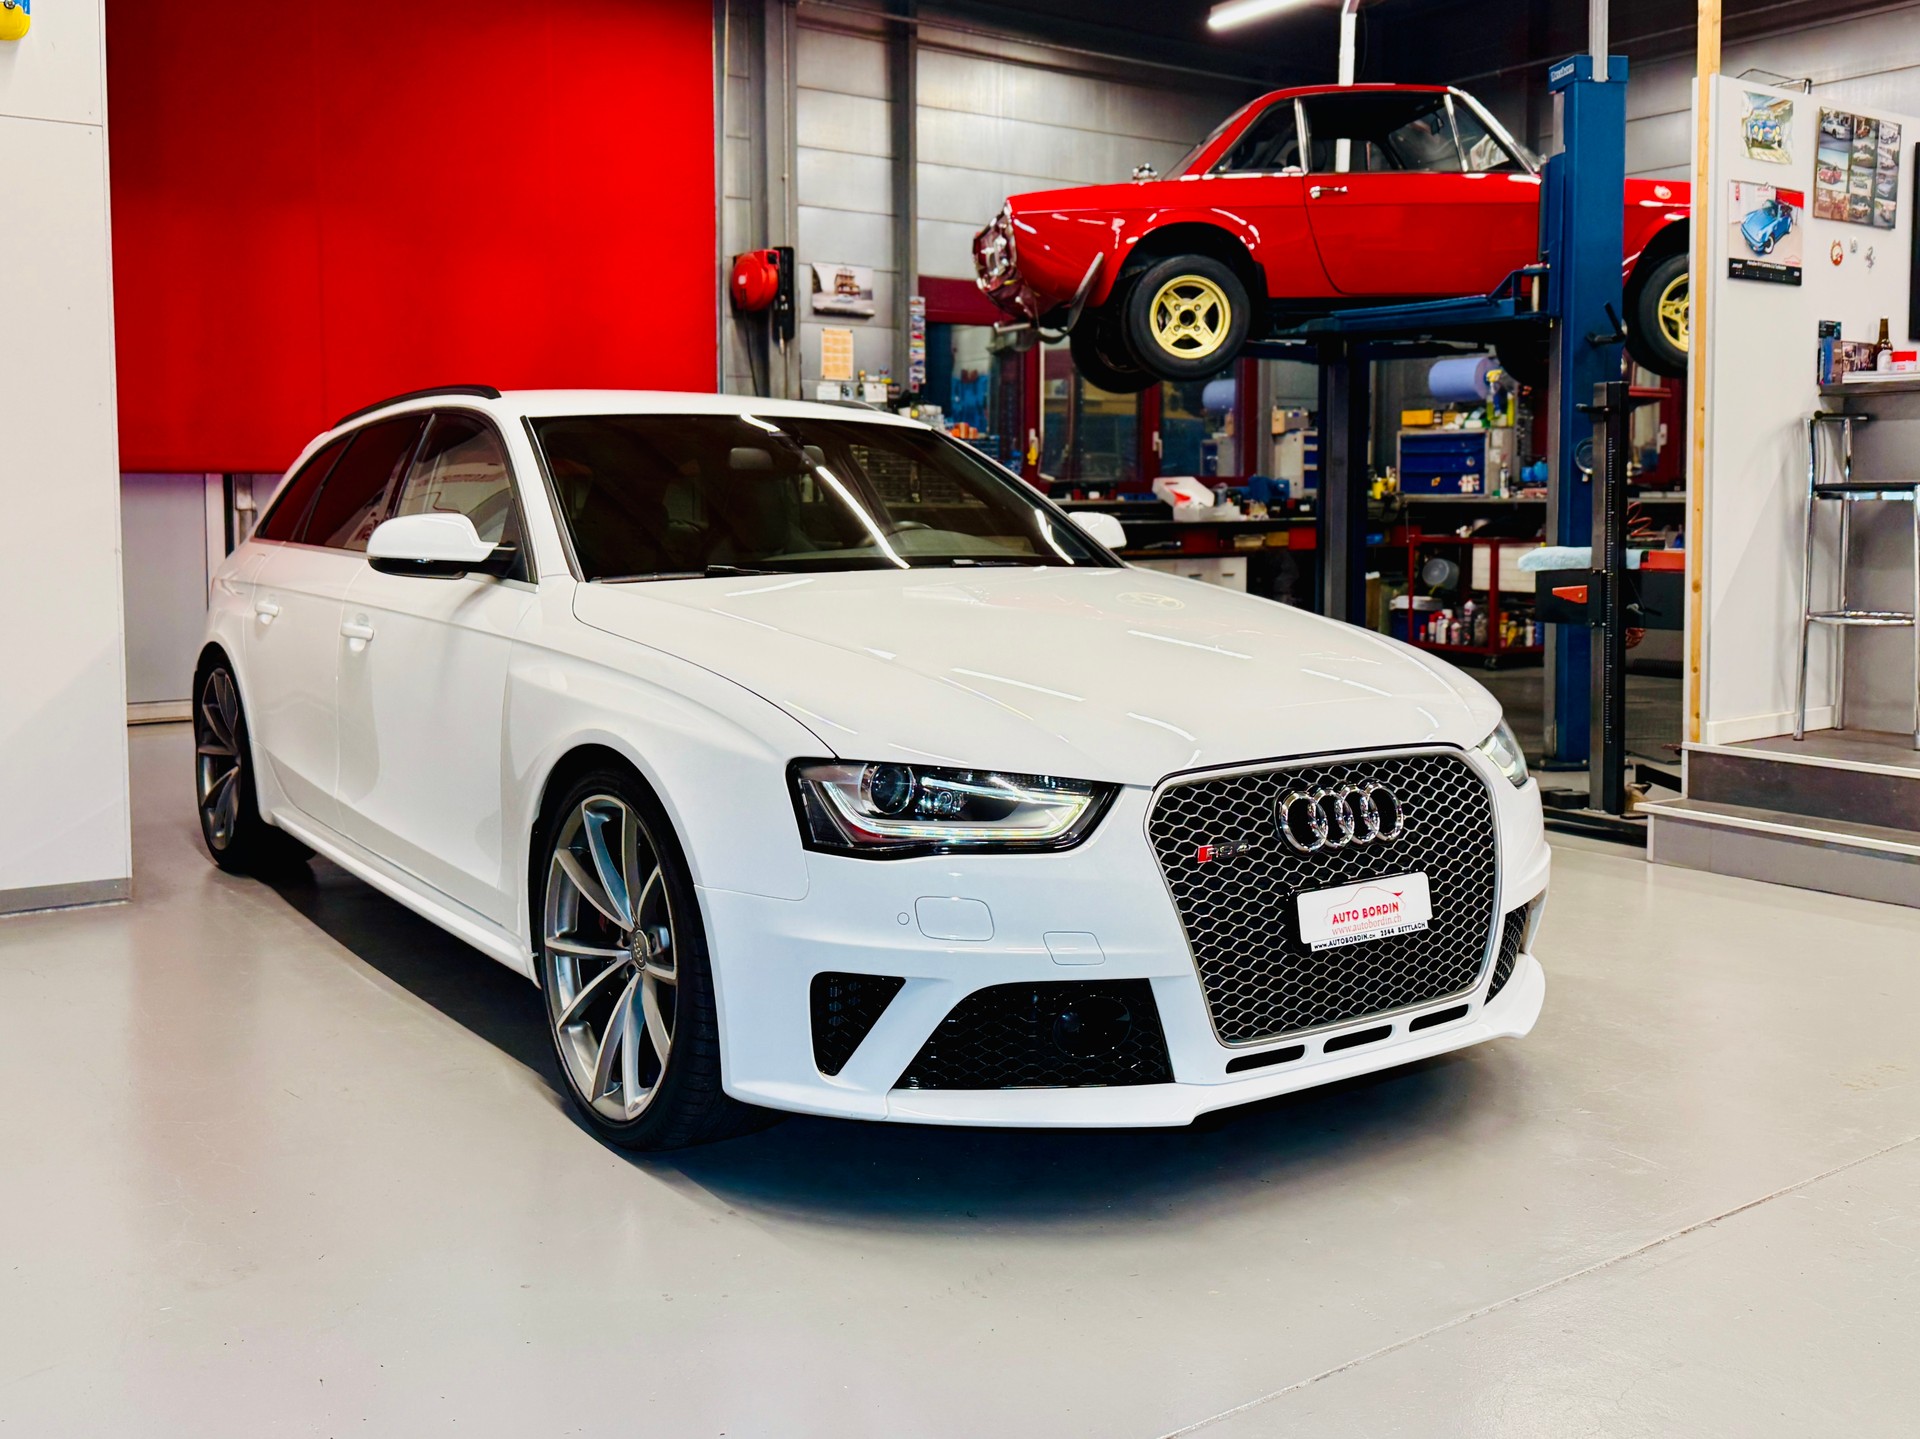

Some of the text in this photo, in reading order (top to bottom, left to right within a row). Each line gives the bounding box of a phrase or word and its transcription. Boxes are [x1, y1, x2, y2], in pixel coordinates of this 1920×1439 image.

[1332, 902, 1399, 925] AUTO BORDIN
[1331, 914, 1402, 936] www.autobordin.ch
